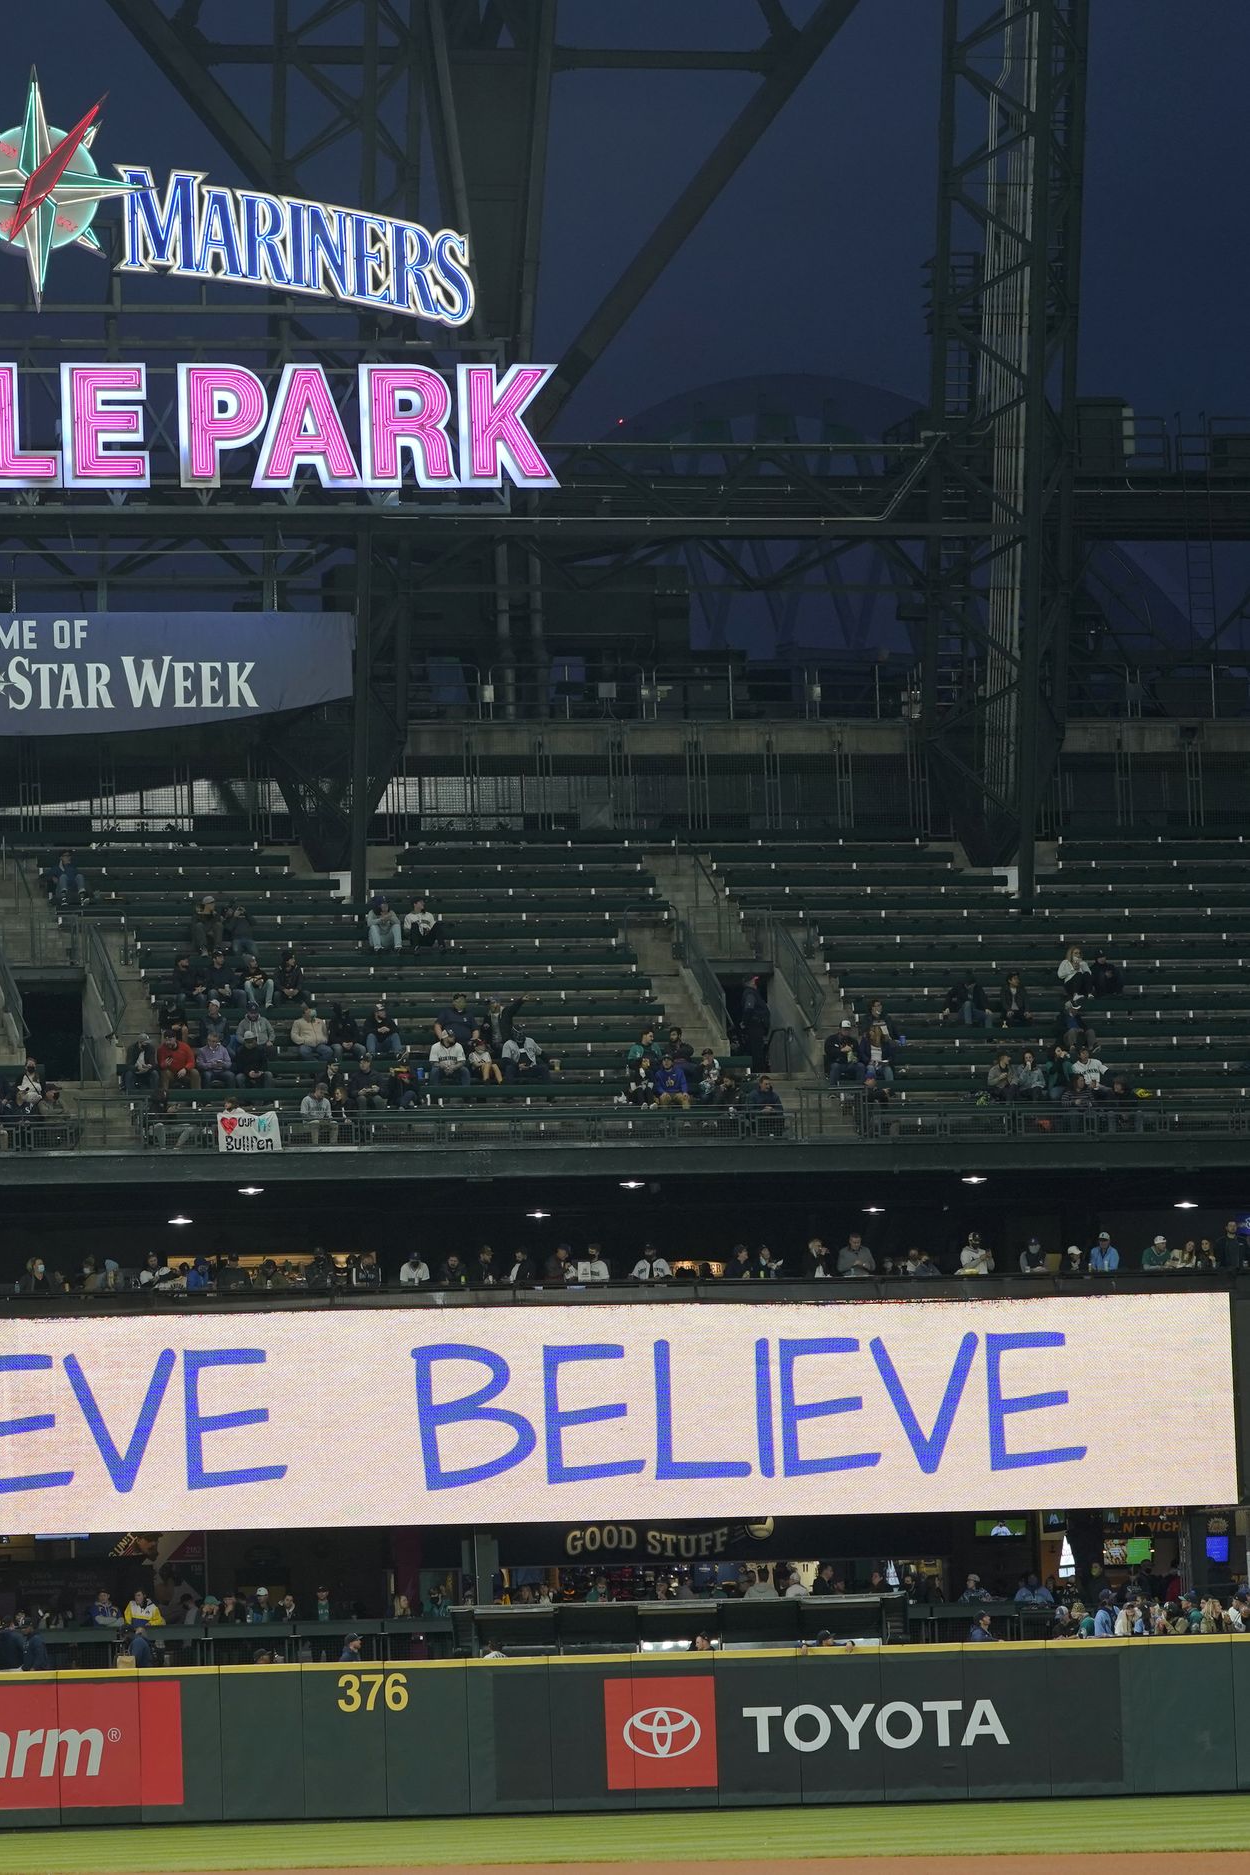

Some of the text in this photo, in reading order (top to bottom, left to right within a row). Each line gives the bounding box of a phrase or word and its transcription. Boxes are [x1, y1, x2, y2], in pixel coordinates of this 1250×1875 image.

[113, 163, 477, 328] MARINERS
[176, 362, 562, 490] PARK
[52, 618, 89, 651] OF
[121, 655, 261, 710] WEEK
[411, 1331, 1088, 1491] BELIEVE
[566, 1525, 729, 1558] GOOD STUFF
[337, 1673, 410, 1714] 376
[742, 1699, 1011, 1754] TOYOTA
